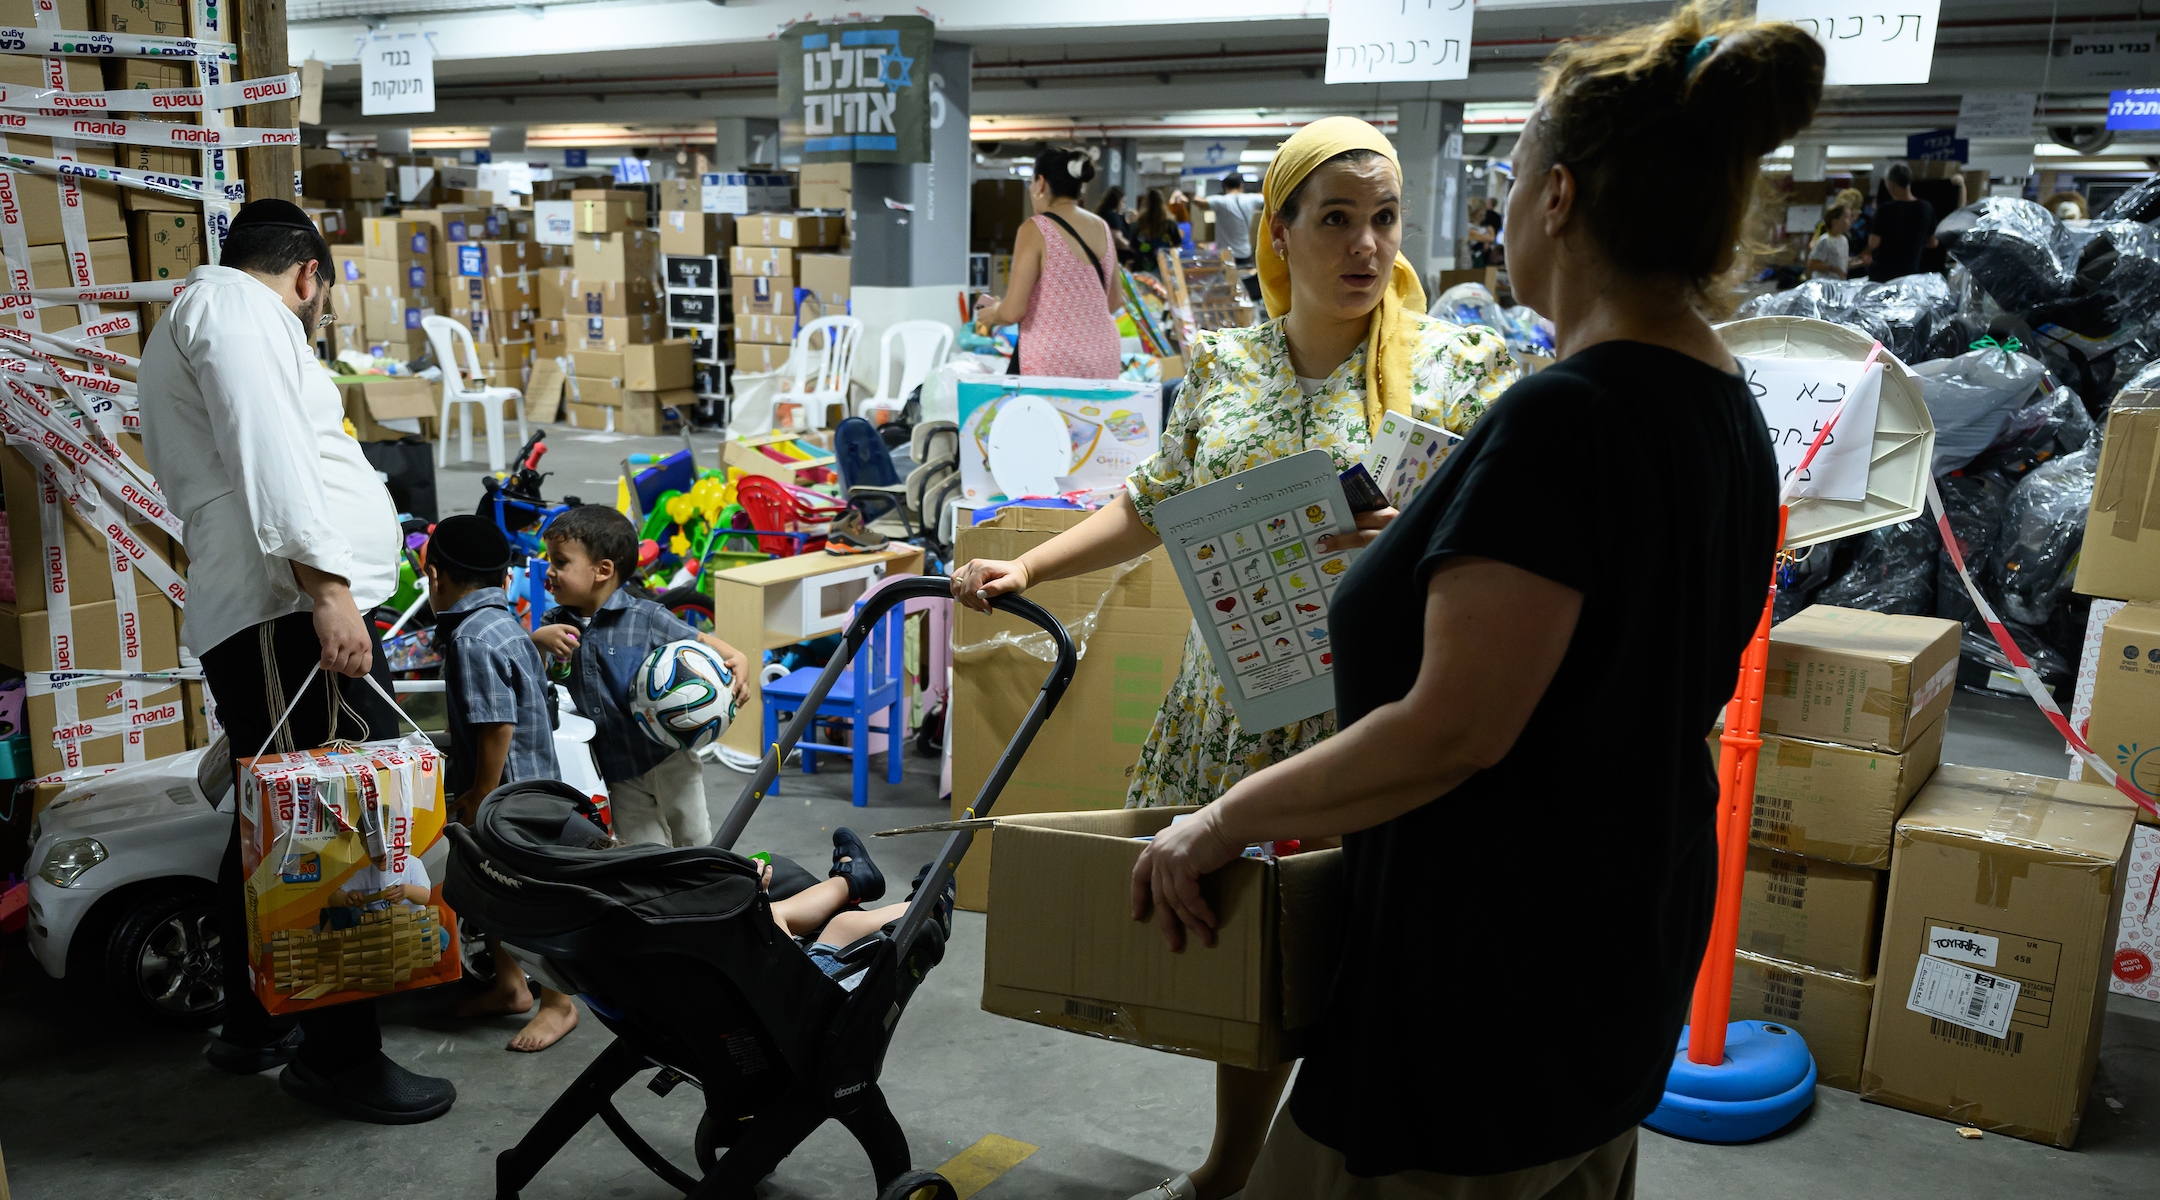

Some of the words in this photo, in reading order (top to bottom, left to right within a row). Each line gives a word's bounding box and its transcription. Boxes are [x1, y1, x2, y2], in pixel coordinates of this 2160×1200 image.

[1, 29, 24, 40] Agro
[91, 35, 113, 44] Agro
[49, 42, 115, 54] GADOT
[2073, 44, 2115, 55] גברים
[2119, 43, 2151, 54] בגדי
[382, 50, 411, 66] בגדי
[1334, 39, 1460, 74] תינוקות
[803, 42, 888, 92] כולנו
[243, 81, 287, 100] manta
[371, 78, 423, 100] תינוקות
[53, 97, 107, 108] manta
[152, 94, 204, 109] manta
[0, 114, 26, 126] nta
[803, 92, 897, 135] אחים
[73, 120, 126, 136] manta
[171, 128, 220, 143] manta
[59, 164, 122, 182] GADOT
[143, 175, 204, 191] GADOT
[0, 172, 19, 225] manta
[78, 290, 130, 302] manta
[86, 317, 131, 337] manta
[71, 374, 121, 394] manta
[44, 430, 91, 466] manta
[121, 484, 164, 519] manta
[107, 523, 146, 561] manta
[50, 546, 66, 594] manta
[124, 612, 140, 659] manta
[50, 680, 70, 690] Agro
[132, 705, 175, 725] manta
[1869, 758, 1877, 771] A
[393, 816, 409, 874] manta
[2026, 941, 2038, 949] UK
[2013, 954, 2032, 964] 458
[2121, 964, 2144, 972] הרשמי
[2023, 988, 2037, 997] PK12
[2026, 982, 2053, 993] STACKING
